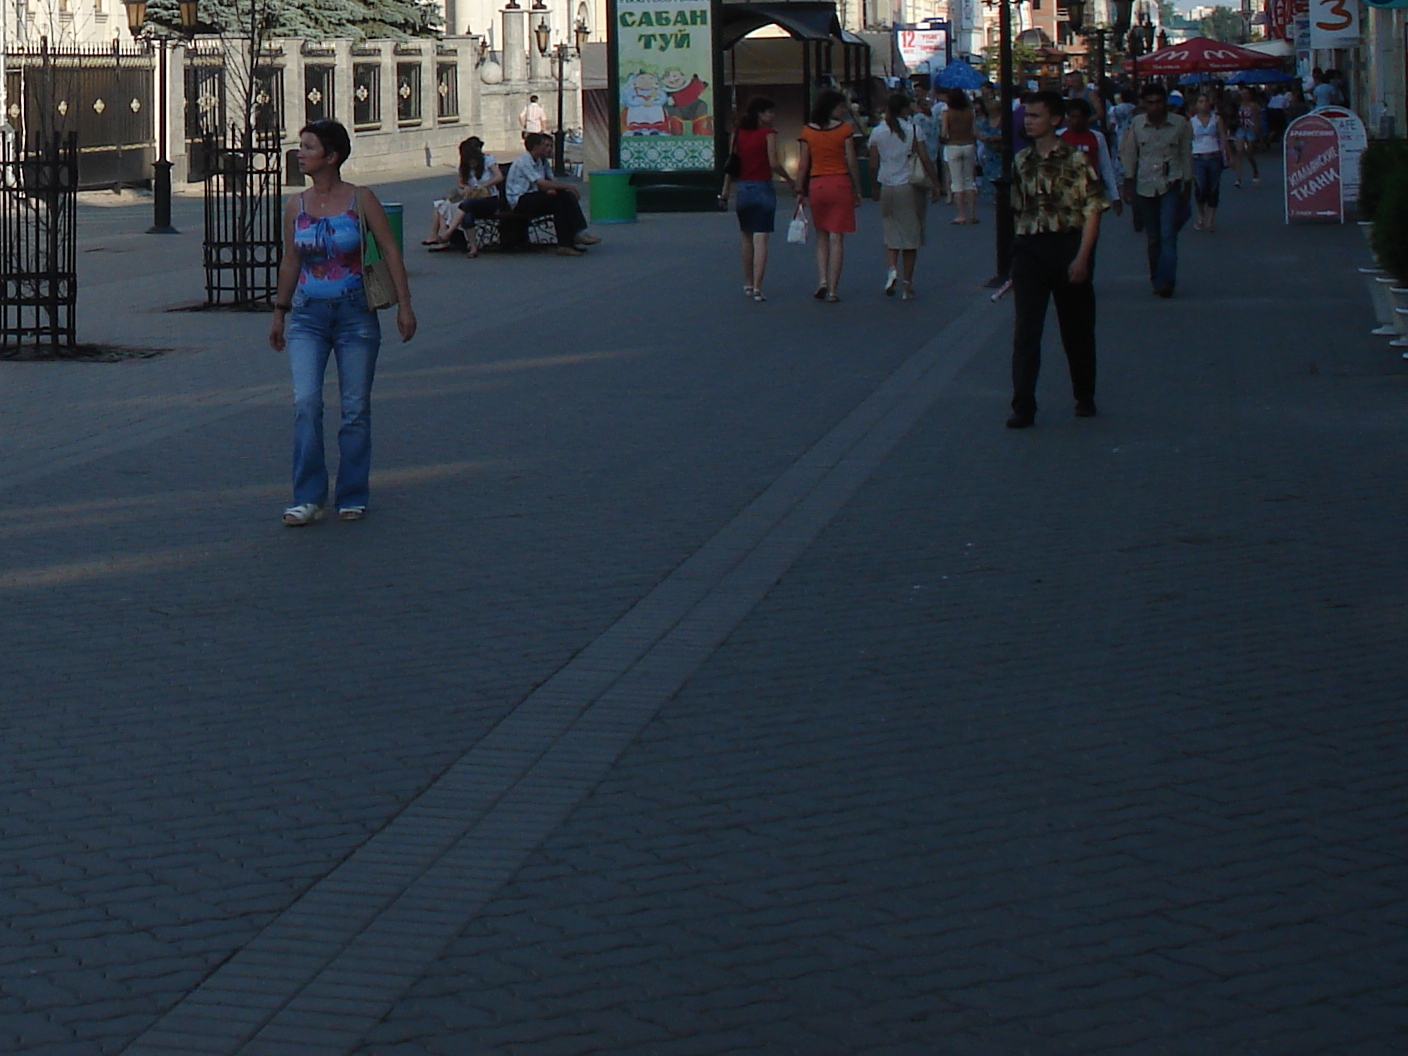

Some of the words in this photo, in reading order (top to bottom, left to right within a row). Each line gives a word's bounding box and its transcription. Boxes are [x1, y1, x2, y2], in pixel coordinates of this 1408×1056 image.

[619, 9, 708, 28] САБАН
[637, 28, 691, 52] ТУЙ
[901, 30, 915, 48] 12
[1290, 167, 1341, 201] ТКАНИ
